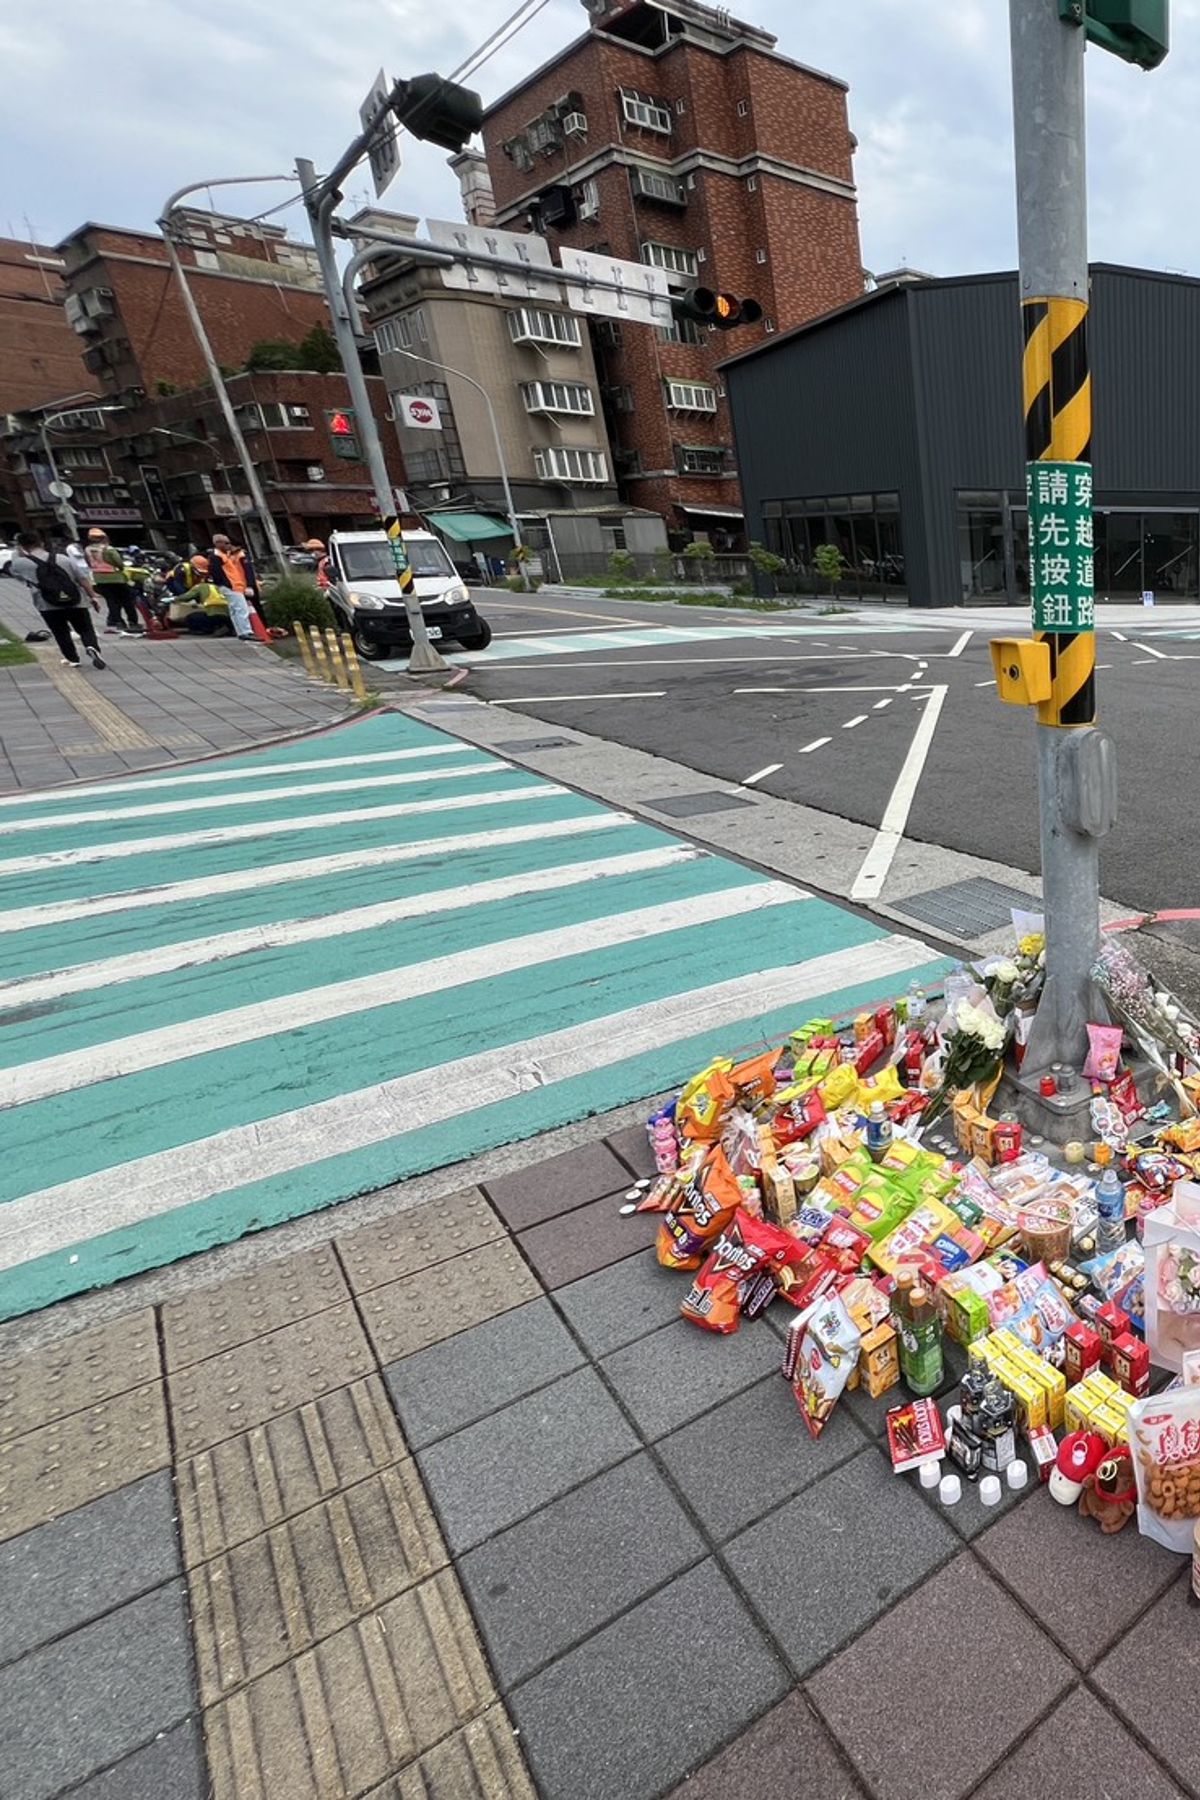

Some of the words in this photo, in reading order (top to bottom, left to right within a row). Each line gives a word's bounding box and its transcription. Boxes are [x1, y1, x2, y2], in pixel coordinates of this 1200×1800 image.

[410, 407, 433, 418] SYM
[1038, 469, 1073, 626] 請先按鈕
[1074, 472, 1094, 626] 穿越道路
